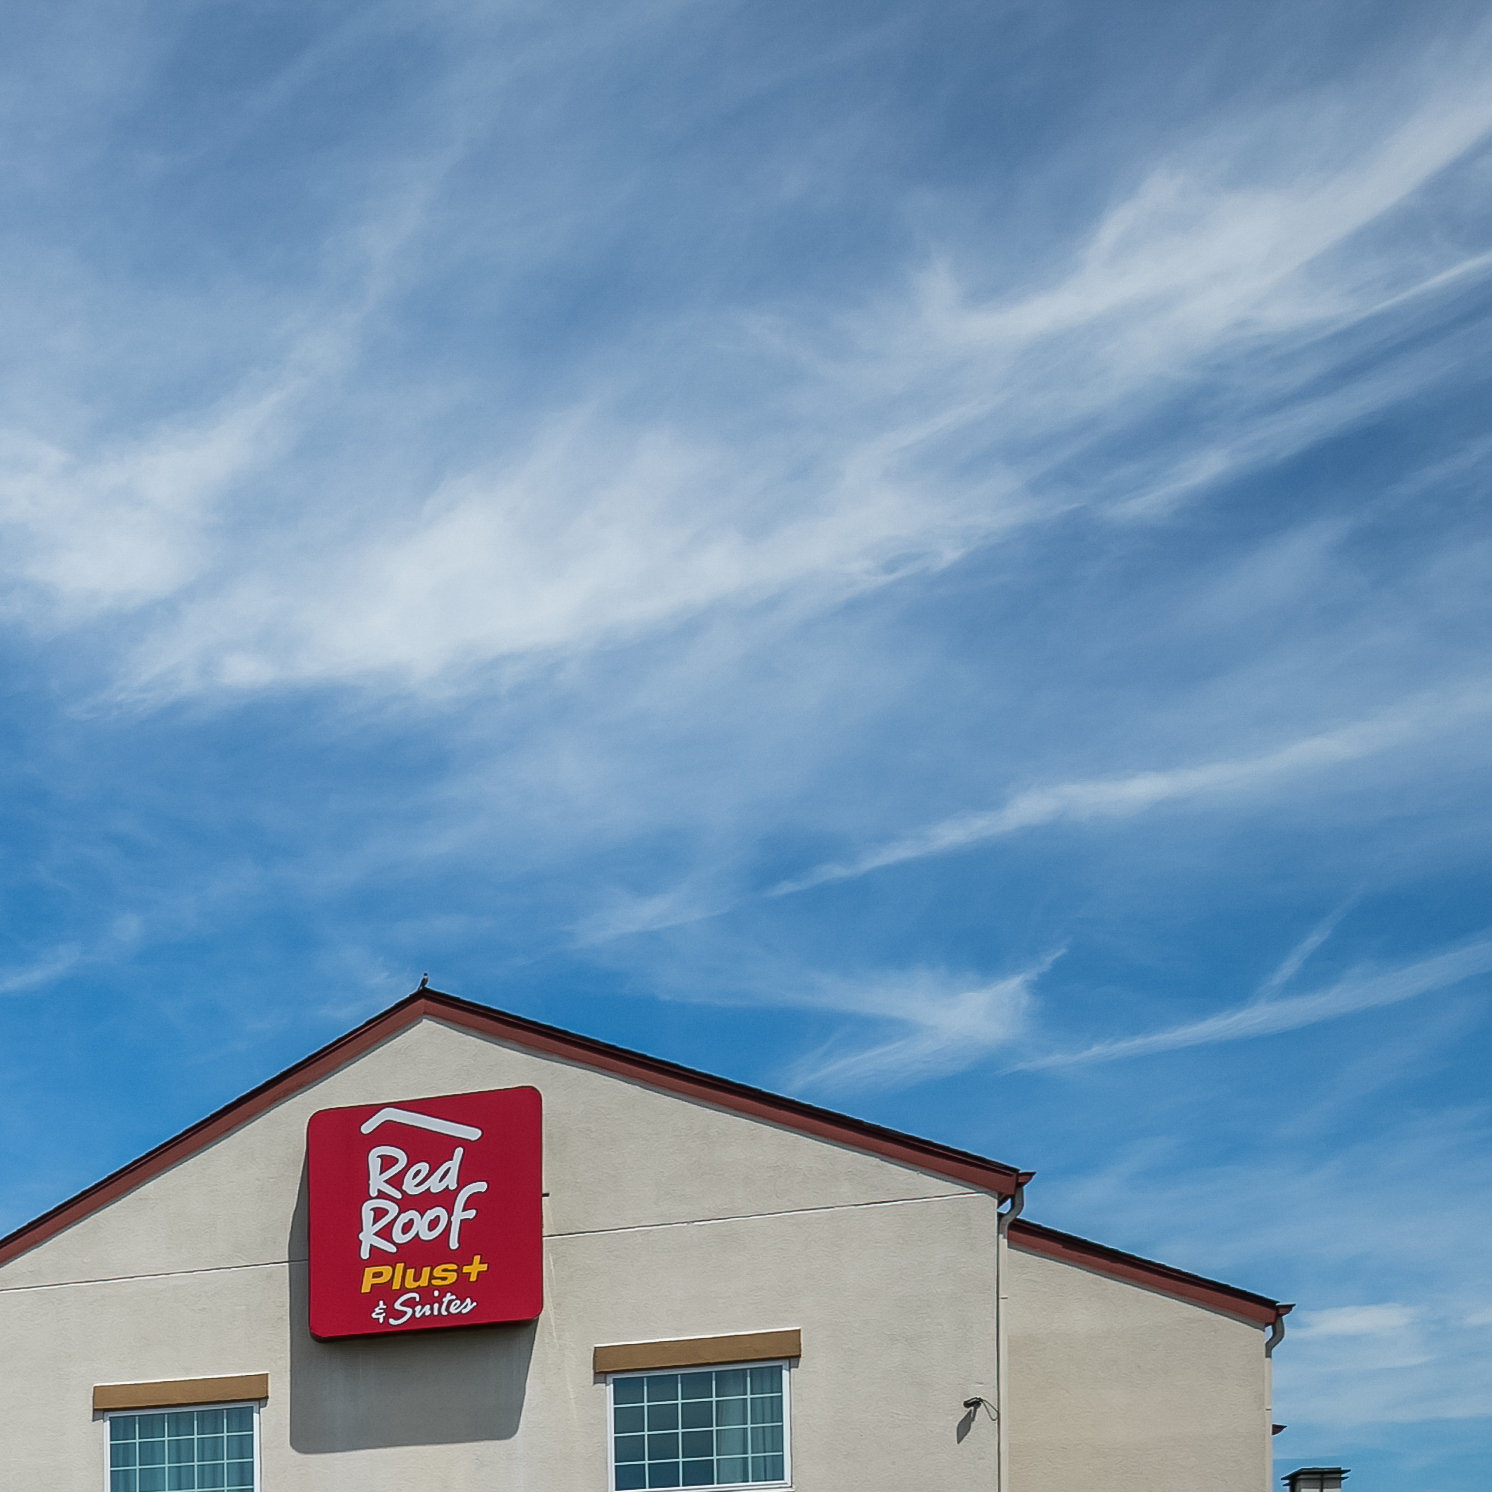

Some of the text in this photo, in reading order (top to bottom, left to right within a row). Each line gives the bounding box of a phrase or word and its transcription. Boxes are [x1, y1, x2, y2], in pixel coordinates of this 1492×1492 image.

[368, 1145, 464, 1200] Red
[359, 1181, 488, 1260] Roof
[360, 1255, 488, 1294] Plus+
[371, 1290, 477, 1326] & Suites
